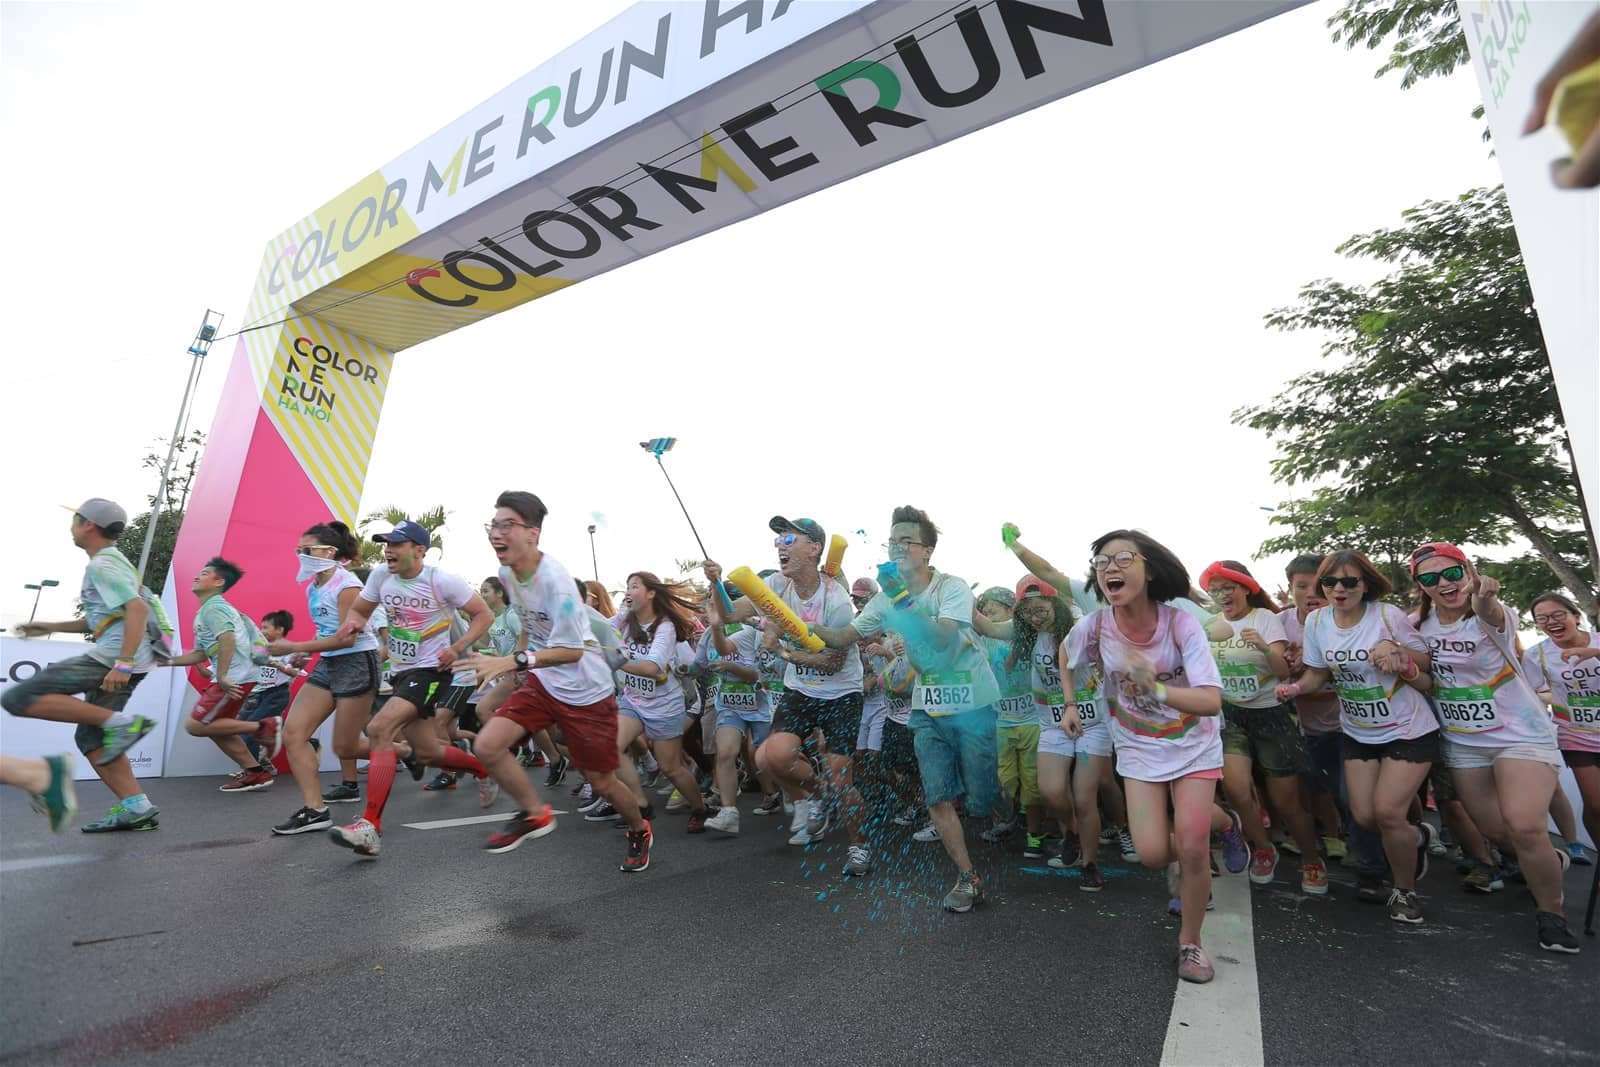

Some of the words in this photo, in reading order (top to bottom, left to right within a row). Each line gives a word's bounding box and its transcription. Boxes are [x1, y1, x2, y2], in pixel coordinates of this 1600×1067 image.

[268, 178, 408, 295] COLOR
[416, 114, 505, 215] ME
[516, 11, 672, 160] RUN
[406, 185, 663, 307] COLOR
[637, 102, 820, 214] ME
[815, 0, 1114, 148] RUN
[287, 355, 327, 385] ME
[293, 336, 378, 385] COLOR
[281, 376, 335, 410] RUN
[278, 395, 300, 413] HA
[304, 405, 331, 422] NOI
[384, 594, 430, 608] COLOR
[1325, 649, 1374, 662] COLO
[1428, 639, 1476, 653] OLOR
[625, 674, 654, 692] A3193
[924, 686, 970, 705] A3562
[1001, 694, 1034, 712] B7732
[1051, 703, 1095, 722] B39
[1341, 699, 1390, 718] B5570
[1440, 703, 1496, 721] B6623
